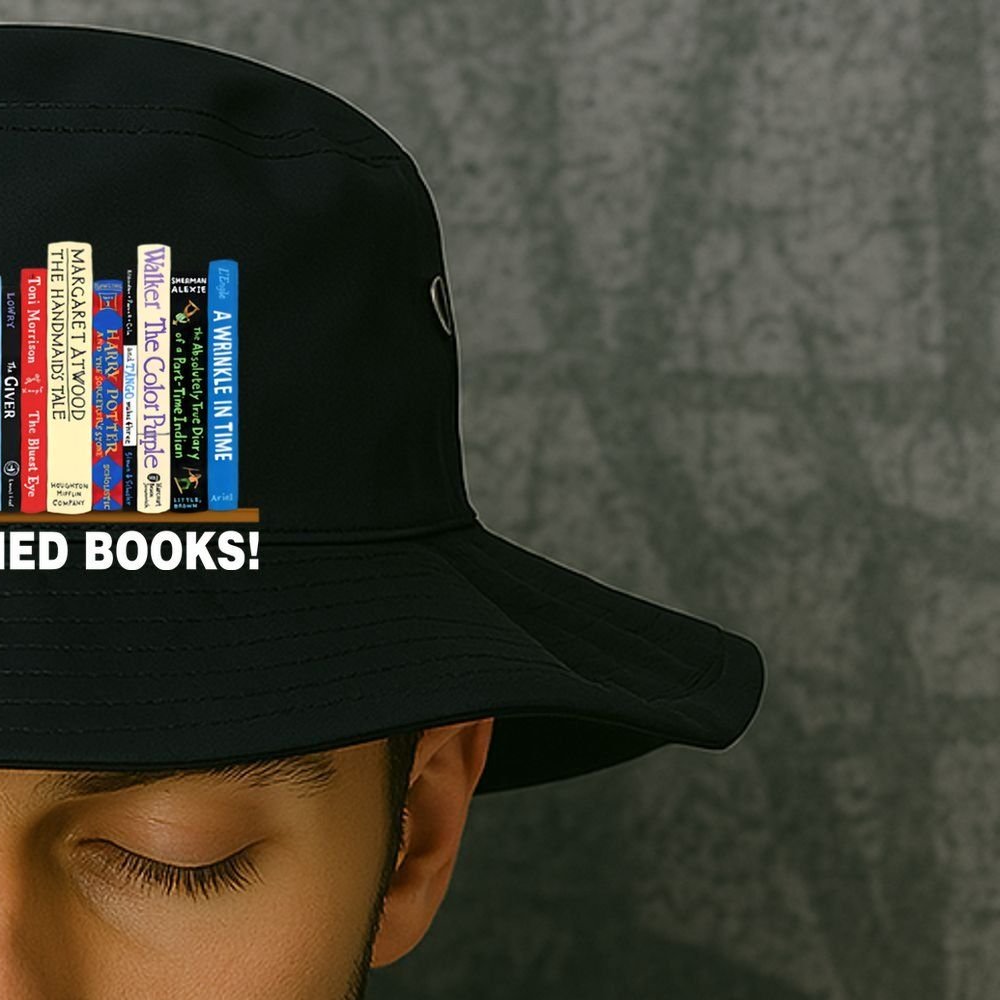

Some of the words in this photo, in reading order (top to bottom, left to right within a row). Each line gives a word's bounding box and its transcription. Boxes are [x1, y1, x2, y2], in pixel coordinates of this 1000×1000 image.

[50, 248, 64, 282] THE
[143, 247, 166, 310] Walker
[6, 292, 15, 329] LOWRY
[27, 276, 41, 305] Toni
[70, 248, 86, 344] MARGARET
[50, 289, 64, 381] HANDMAID'S
[144, 317, 167, 352] The
[213, 310, 232, 322] A
[27, 309, 41, 364] Morrison
[96, 331, 104, 352] AND
[104, 329, 120, 381] HARRY
[175, 332, 186, 344] of
[189, 343, 204, 400] Absolutely
[213, 325, 233, 394] WRINKLE
[4, 376, 19, 418] GIVER
[51, 385, 66, 420] TALE
[70, 346, 86, 421] ATWOOD
[143, 356, 166, 411] Color
[173, 357, 186, 415] Part-Time
[28, 410, 40, 433] The
[104, 389, 119, 457] POTTER
[192, 401, 204, 424] True
[213, 399, 233, 417] IN
[125, 421, 134, 444] three
[139, 413, 166, 469] Purple
[174, 416, 187, 458] Indian
[187, 427, 204, 460] Diary
[214, 421, 233, 461] TIME
[28, 438, 40, 472] Bluest
[24, 475, 40, 497] Eye
[86, 530, 260, 570] BOOKS!
